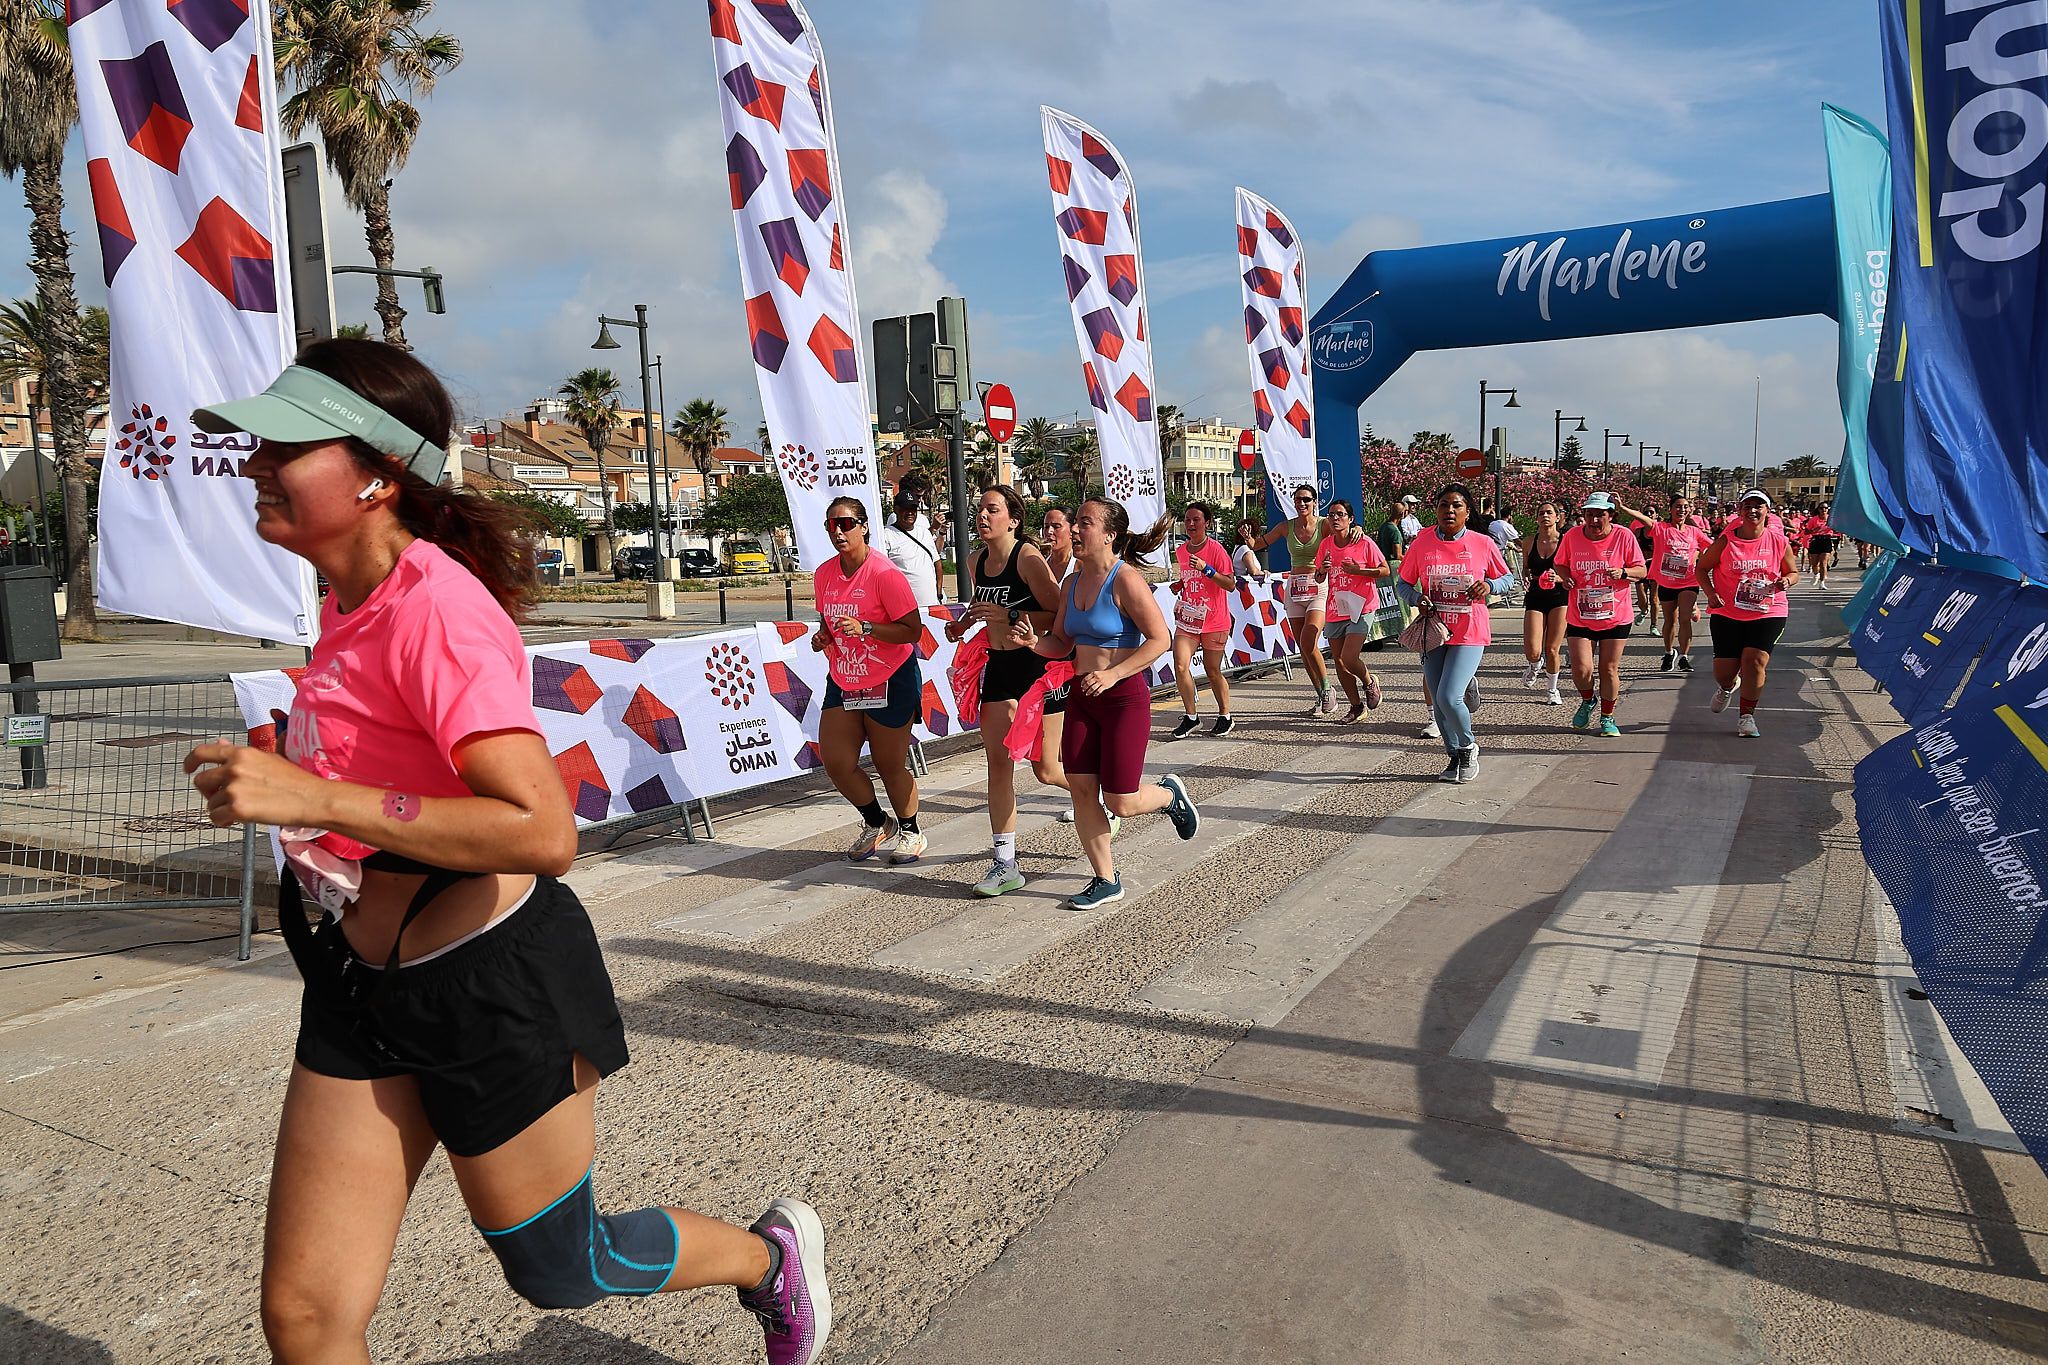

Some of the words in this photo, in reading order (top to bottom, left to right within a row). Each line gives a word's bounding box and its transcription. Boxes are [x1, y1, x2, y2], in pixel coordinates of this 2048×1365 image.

[1496, 228, 1706, 322] Marlene
[1315, 332, 1369, 359] Marlene
[1349, 355, 1365, 366] ALPES
[320, 396, 365, 425] KIPRUN
[1426, 563, 1467, 576] CARRERA
[1576, 560, 1610, 571] CARRERA
[1732, 560, 1768, 570] CARRERA
[1594, 573, 1606, 586] DE
[975, 585, 1011, 606] NIKE
[1442, 591, 1459, 599] 016
[824, 603, 860, 617] CARRERA
[837, 656, 869, 676] MUJER
[720, 718, 767, 733] Experience
[729, 750, 778, 775] OMAN
[1928, 757, 1969, 788] tiene
[1919, 785, 1978, 811] que
[1958, 807, 1998, 834] ser
